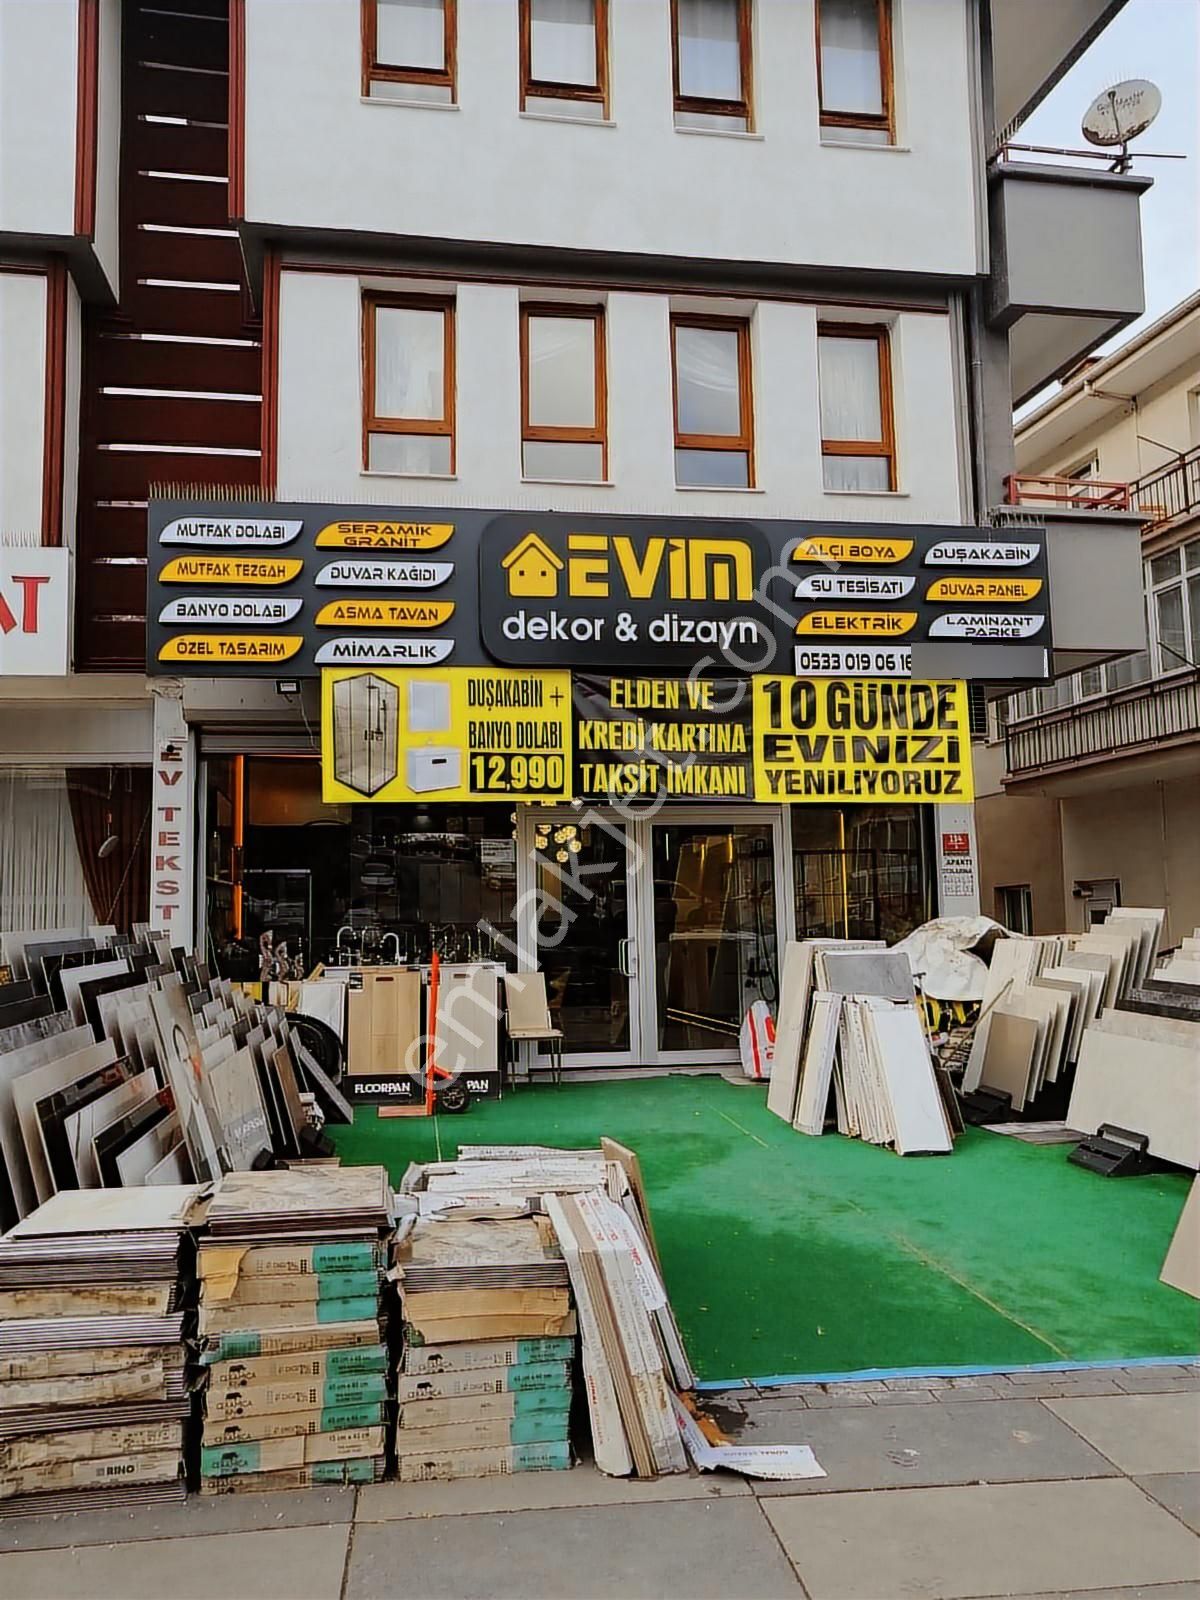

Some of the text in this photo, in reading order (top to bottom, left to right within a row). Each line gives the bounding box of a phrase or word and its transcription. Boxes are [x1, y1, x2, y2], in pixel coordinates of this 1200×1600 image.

[176, 523, 286, 539] MUTFAK DOLABI
[338, 522, 432, 537] SERAMİK
[344, 535, 421, 547] GRANİT
[805, 544, 896, 560] ALÇI BOYA
[933, 543, 1031, 562] DUŞAKABİN
[176, 561, 286, 578] MUTFAK TEZGAH
[330, 565, 436, 581] DUVAR KAĞIDI
[811, 577, 903, 594] SU TESİSATI
[940, 584, 1029, 597] DUVAR PANEL
[176, 604, 286, 617] BANYO DOLABI
[333, 607, 439, 621] ASMA TAVAN
[812, 615, 903, 630] ELEKTRİK
[947, 614, 1033, 627] LAMİNANT
[502, 610, 758, 650] dekor & dizayn
[965, 627, 1021, 637] PARKE
[176, 637, 286, 656] ÖZEL TASARIM
[333, 640, 437, 658] MİMARLIK
[800, 653, 841, 670] 0533
[845, 653, 871, 670] 019
[875, 653, 896, 671] 06
[467, 676, 543, 711] DUŞAKABİN
[610, 678, 714, 710] ELDEN VE
[763, 680, 959, 731] 10 GÜNDE
[468, 721, 563, 749] BANYO DOLABI
[578, 718, 747, 753] KREDİ KARTINA
[763, 734, 960, 764] EVİNİZİ
[580, 760, 746, 795] TAKSİT İMKANI
[766, 769, 963, 795] YENİLİYORUZ
[354, 1082, 411, 1094] FLOORPAN
